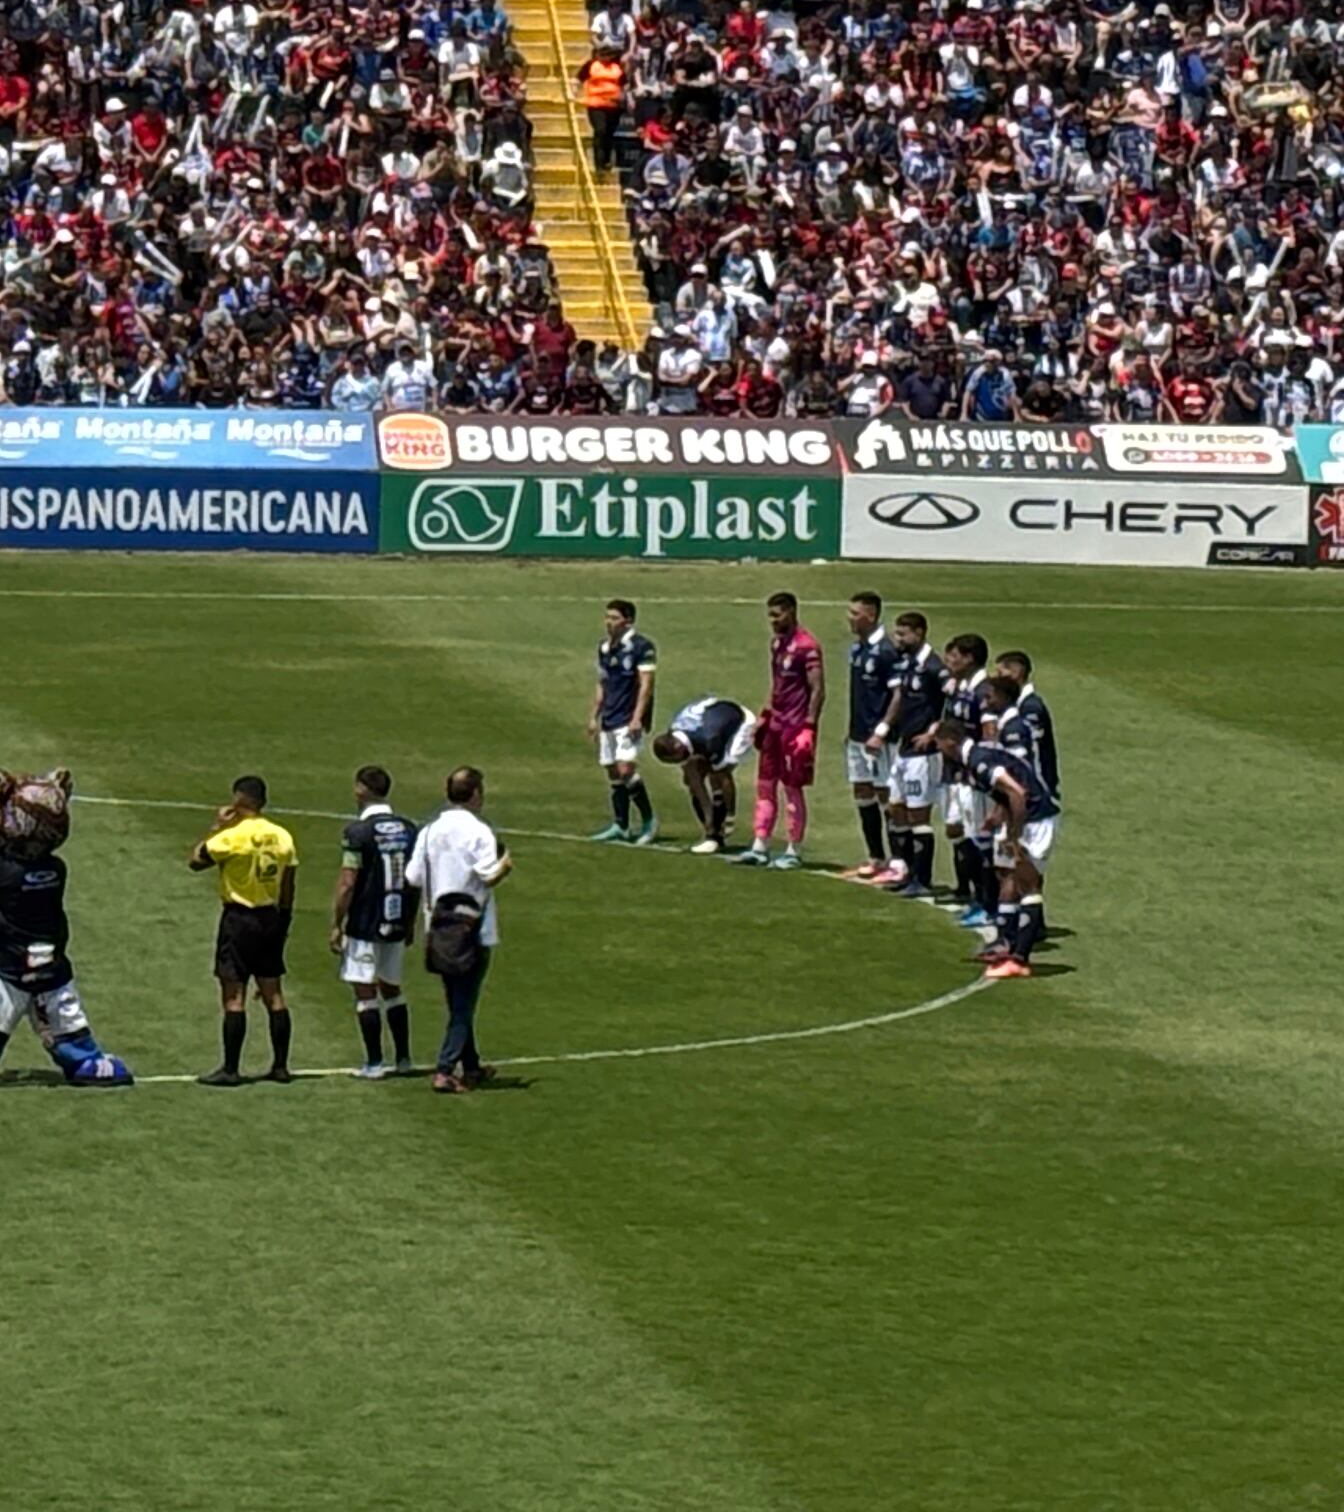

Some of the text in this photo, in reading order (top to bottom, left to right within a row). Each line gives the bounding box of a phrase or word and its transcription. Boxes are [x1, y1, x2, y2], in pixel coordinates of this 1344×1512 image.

[76, 417, 212, 441] Montaña
[227, 418, 363, 443] Montaña
[909, 424, 1093, 454] MÁS QUE POLLO
[385, 441, 446, 457] KING
[456, 425, 831, 465] BURGER KING
[534, 478, 817, 557] Etiplast
[1009, 499, 1278, 536] CHERY
